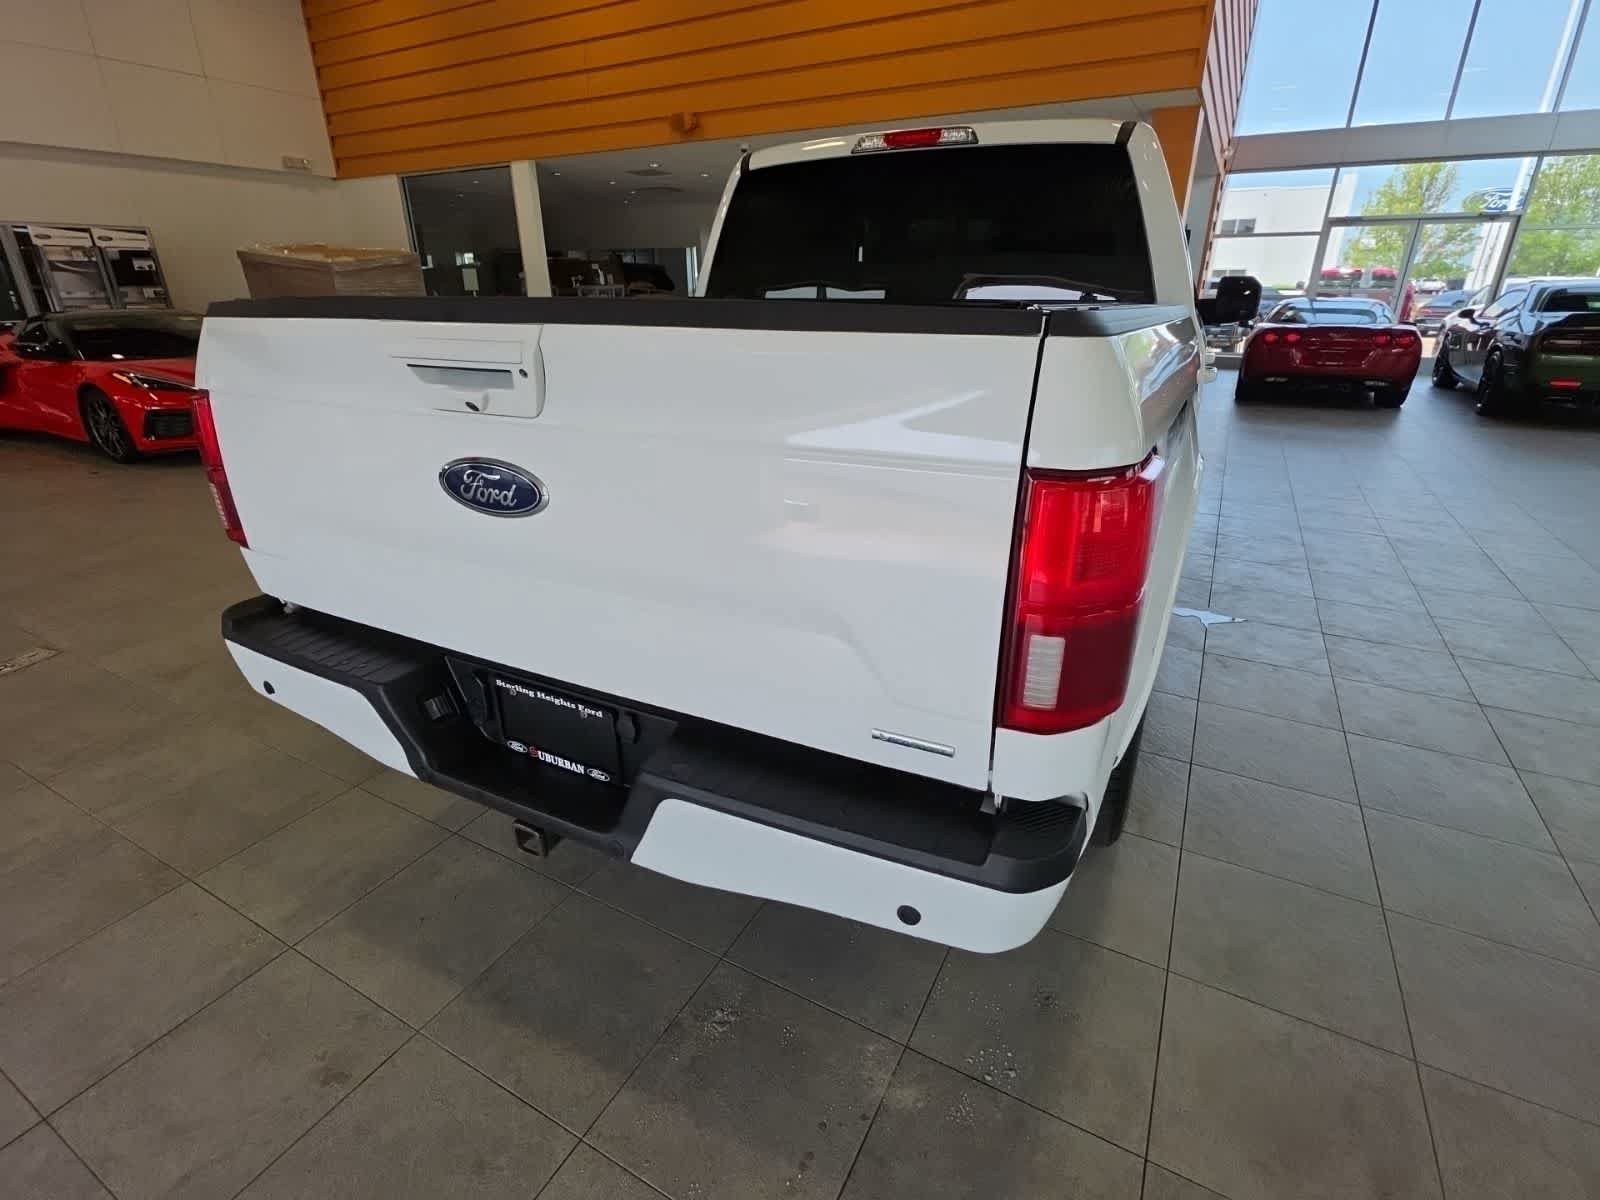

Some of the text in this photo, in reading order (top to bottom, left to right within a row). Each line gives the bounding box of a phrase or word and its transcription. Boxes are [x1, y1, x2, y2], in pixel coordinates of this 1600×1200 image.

[460, 469, 517, 506] Ford
[496, 679, 603, 718] Sterling Heights Ford
[529, 745, 585, 774] SUBURBAN
